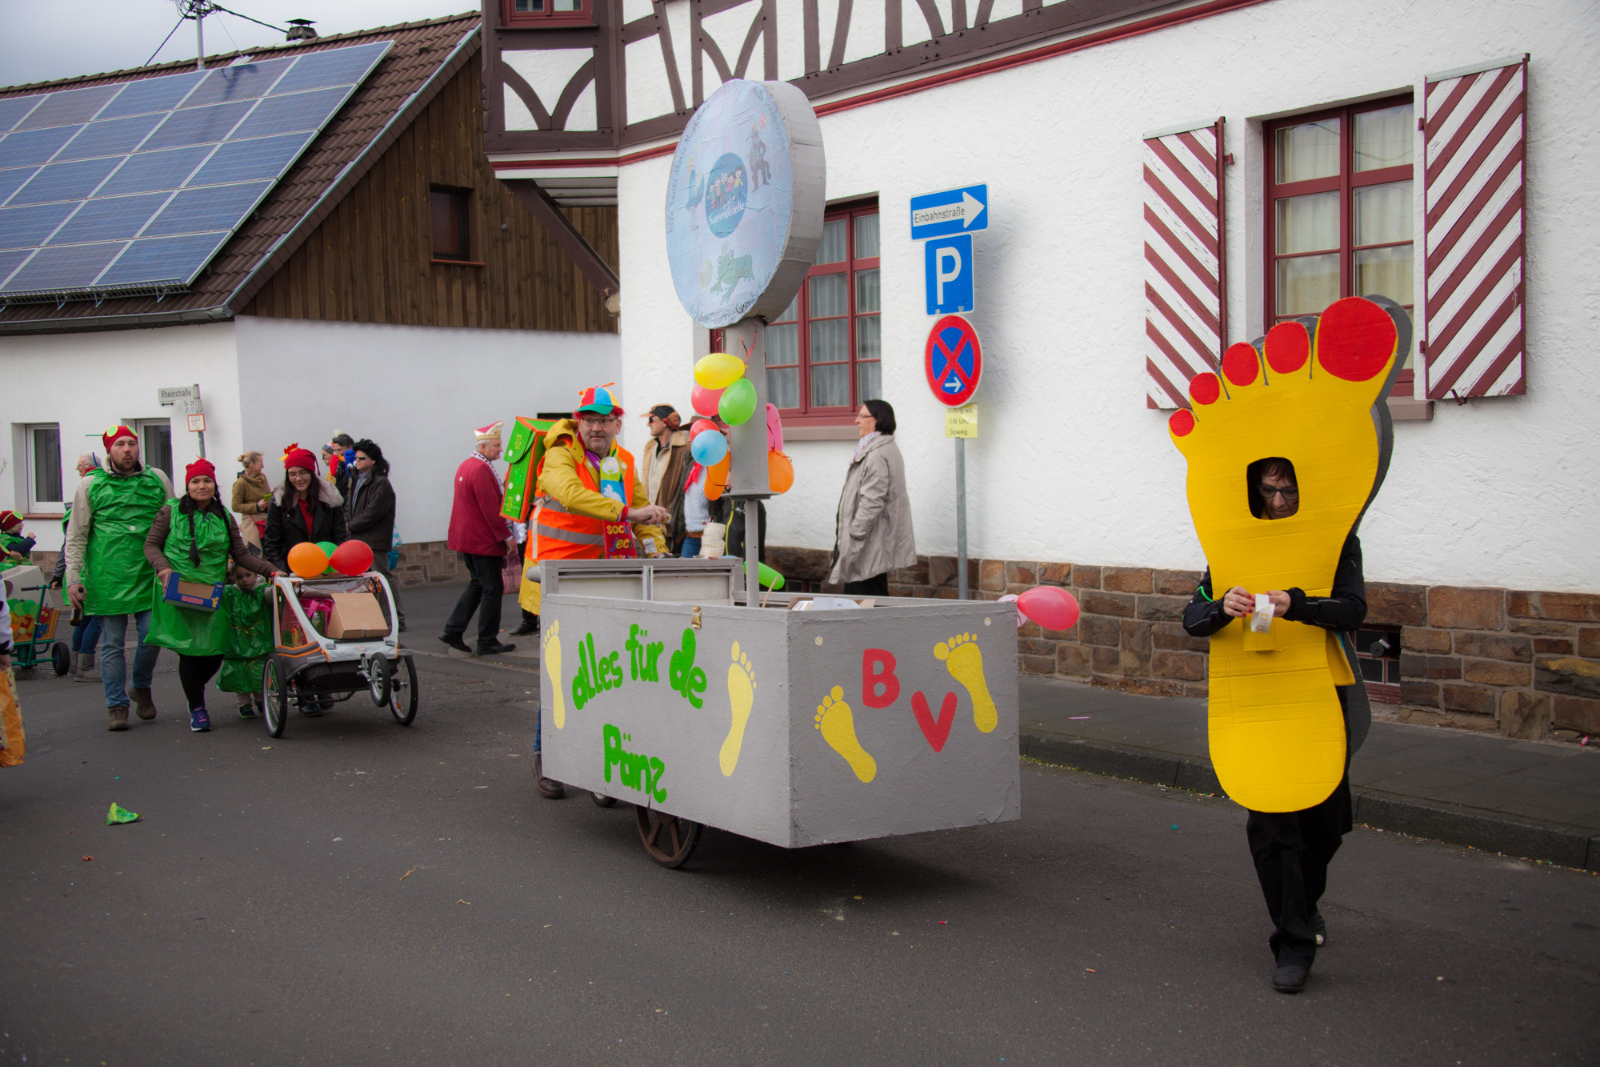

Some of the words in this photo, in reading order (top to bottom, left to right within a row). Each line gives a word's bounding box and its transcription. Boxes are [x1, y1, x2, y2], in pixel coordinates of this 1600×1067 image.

[914, 206, 965, 223] Einbahnstraße
[936, 246, 962, 305] P
[161, 389, 191, 398] Rheinstraße
[609, 536, 634, 552] jeck
[181, 595, 204, 606] HARIBO
[572, 632, 623, 711] alles
[625, 623, 664, 683] für
[669, 628, 707, 709] de
[862, 648, 900, 709] B
[911, 691, 958, 752] V
